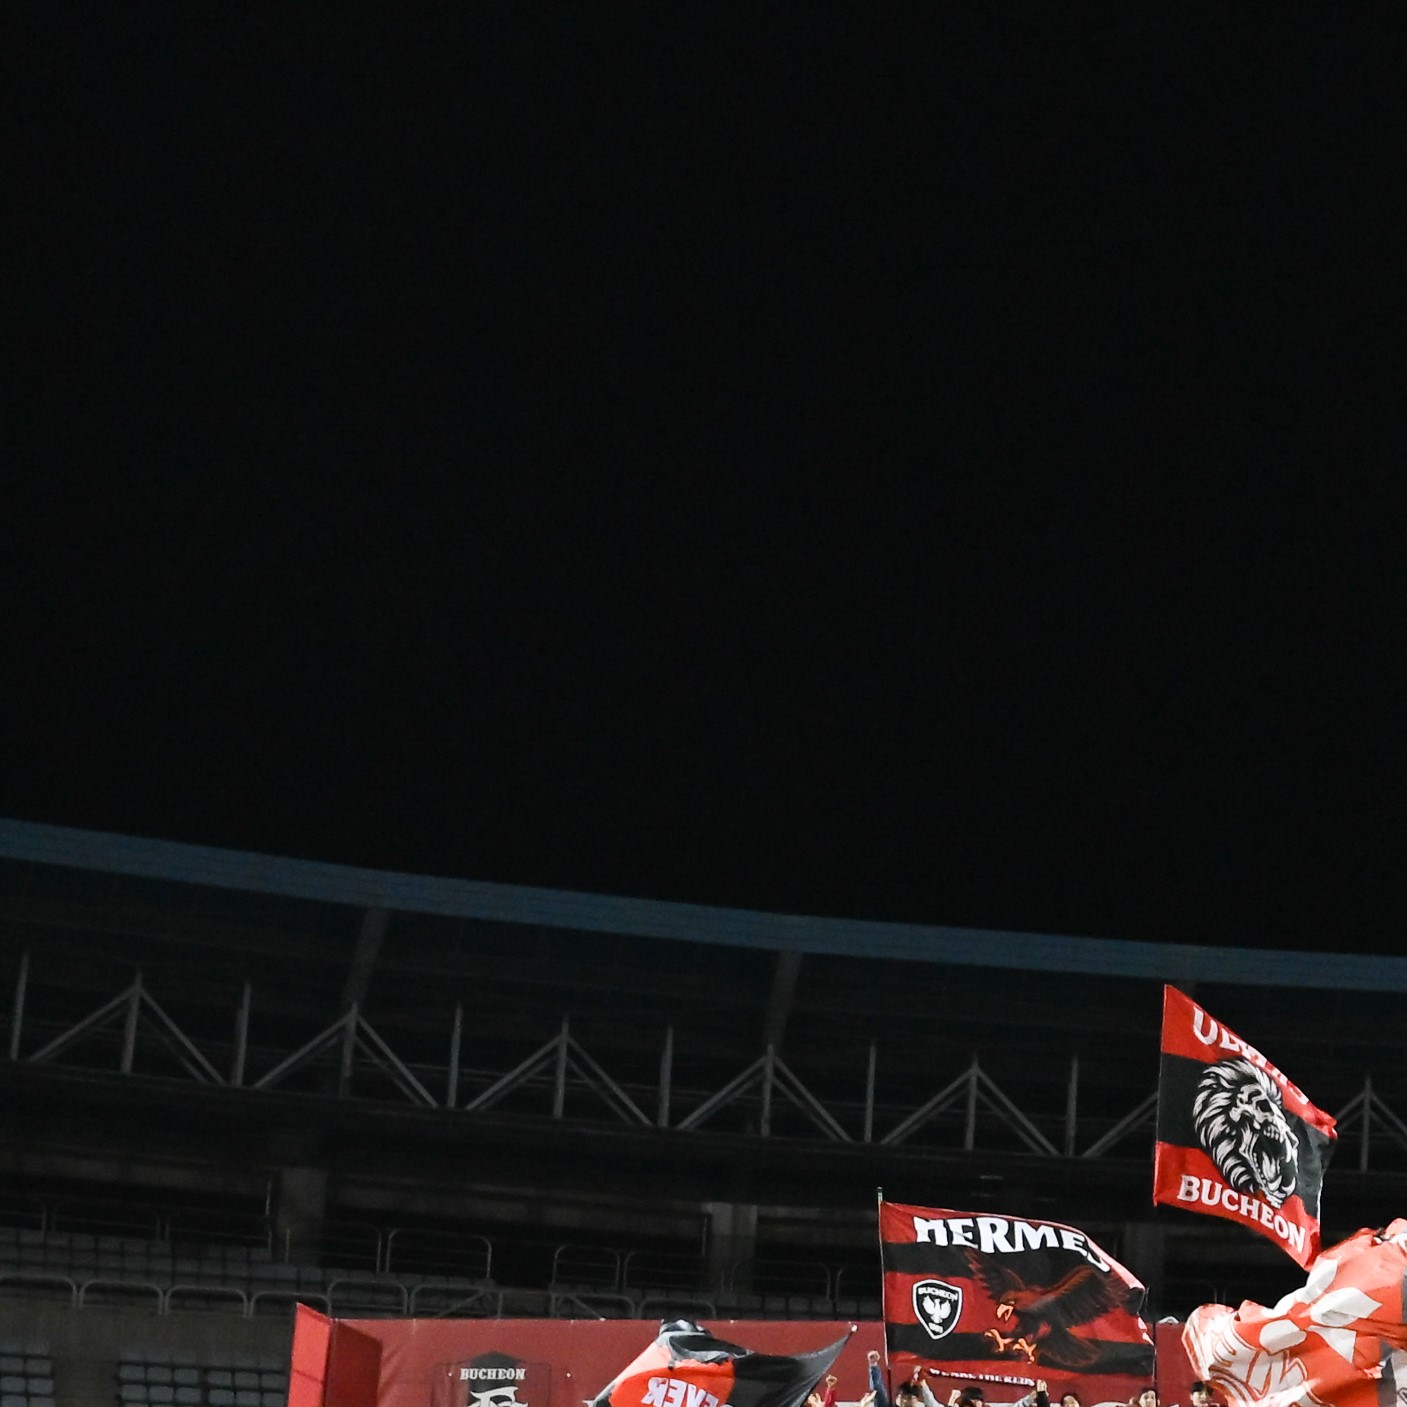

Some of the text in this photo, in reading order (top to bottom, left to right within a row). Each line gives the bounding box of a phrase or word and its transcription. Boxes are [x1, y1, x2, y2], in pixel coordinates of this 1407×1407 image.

[1177, 1174, 1306, 1252] BUCHEON
[918, 1286, 958, 1302] BUCHEON
[460, 1368, 526, 1380] BUCHEON
